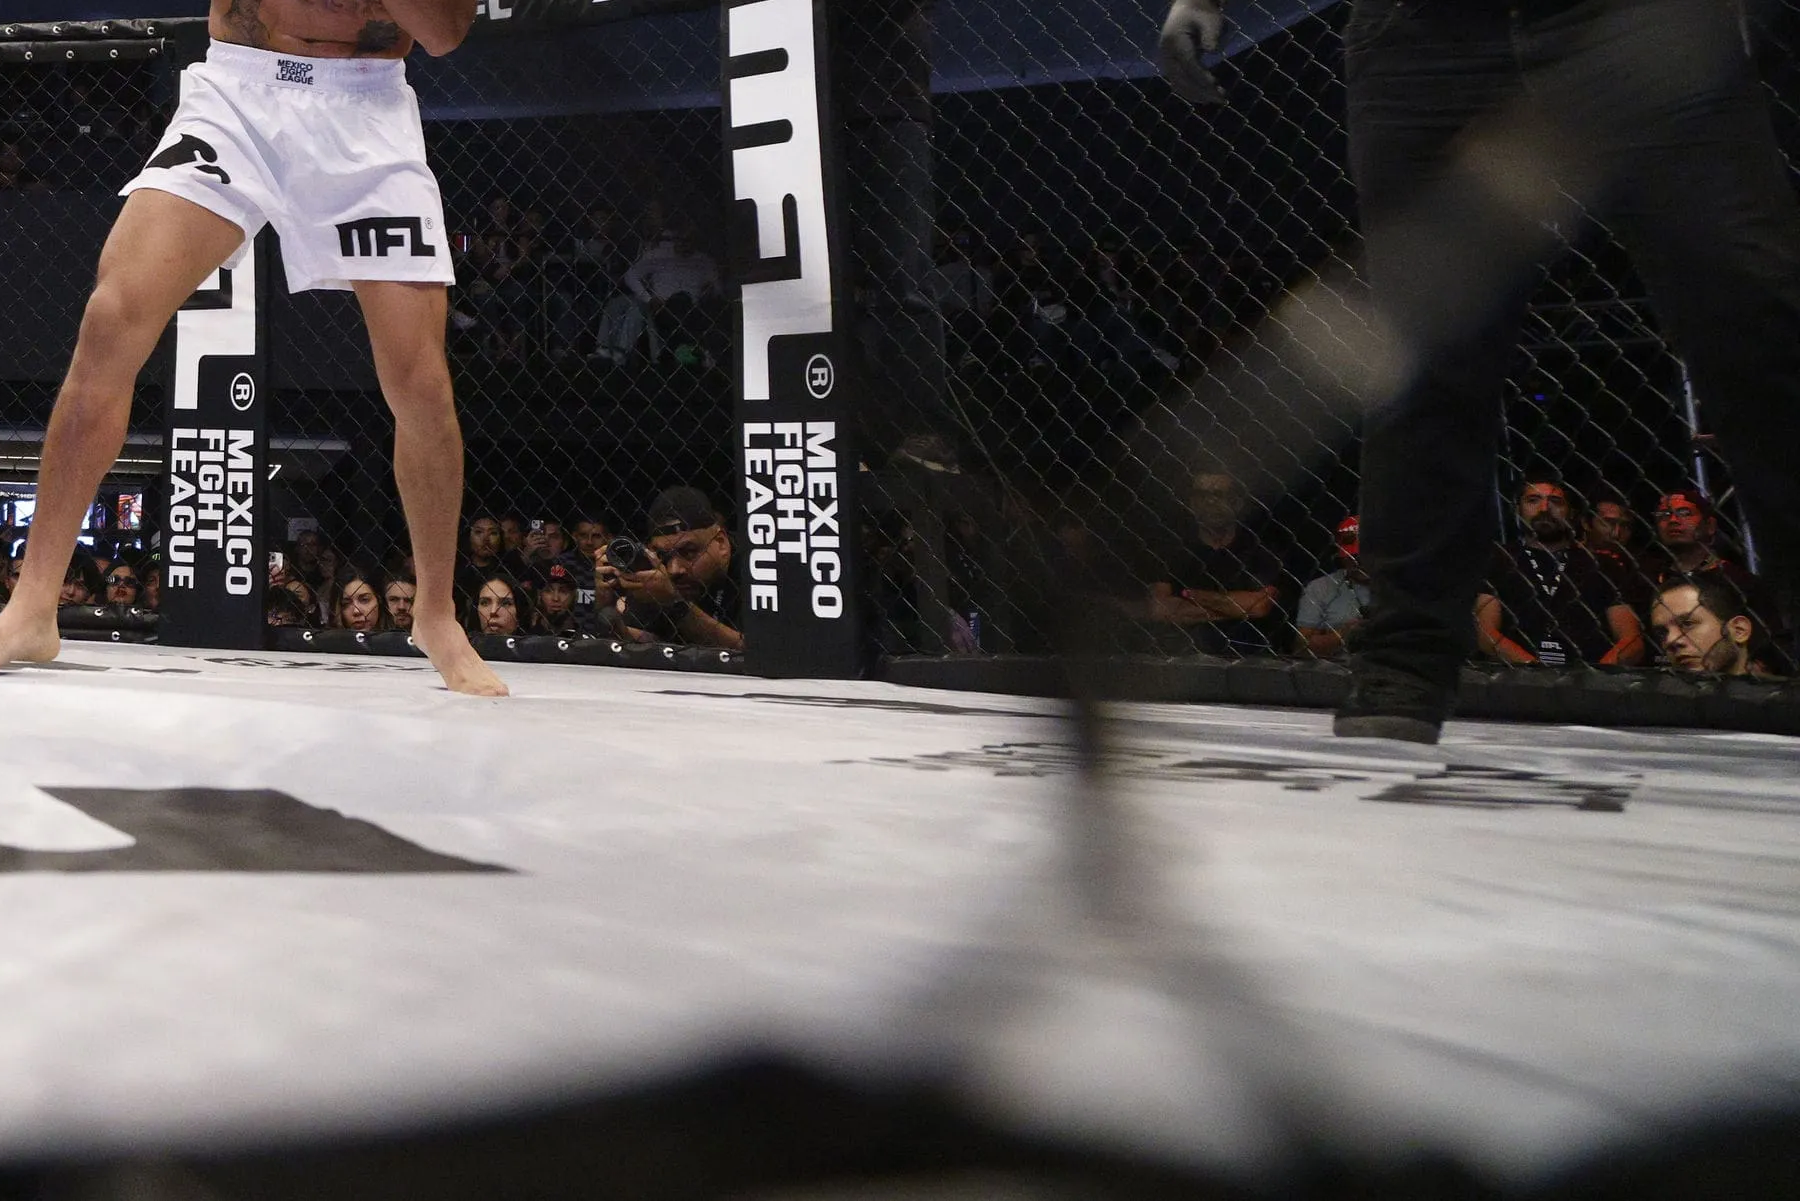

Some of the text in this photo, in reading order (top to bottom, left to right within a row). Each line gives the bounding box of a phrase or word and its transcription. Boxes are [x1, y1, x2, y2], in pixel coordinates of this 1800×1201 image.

[275, 73, 314, 85] LEAGUE
[277, 59, 314, 71] MEXICO
[280, 66, 308, 77] FIGHT
[334, 216, 436, 257] MFL
[168, 428, 198, 590] LEAGUE
[196, 428, 226, 549] FIGHT
[225, 429, 255, 596] MEXICO
[742, 421, 779, 613] LEAGUE
[771, 421, 808, 564] FIGHT
[805, 420, 844, 620] MEXICO
